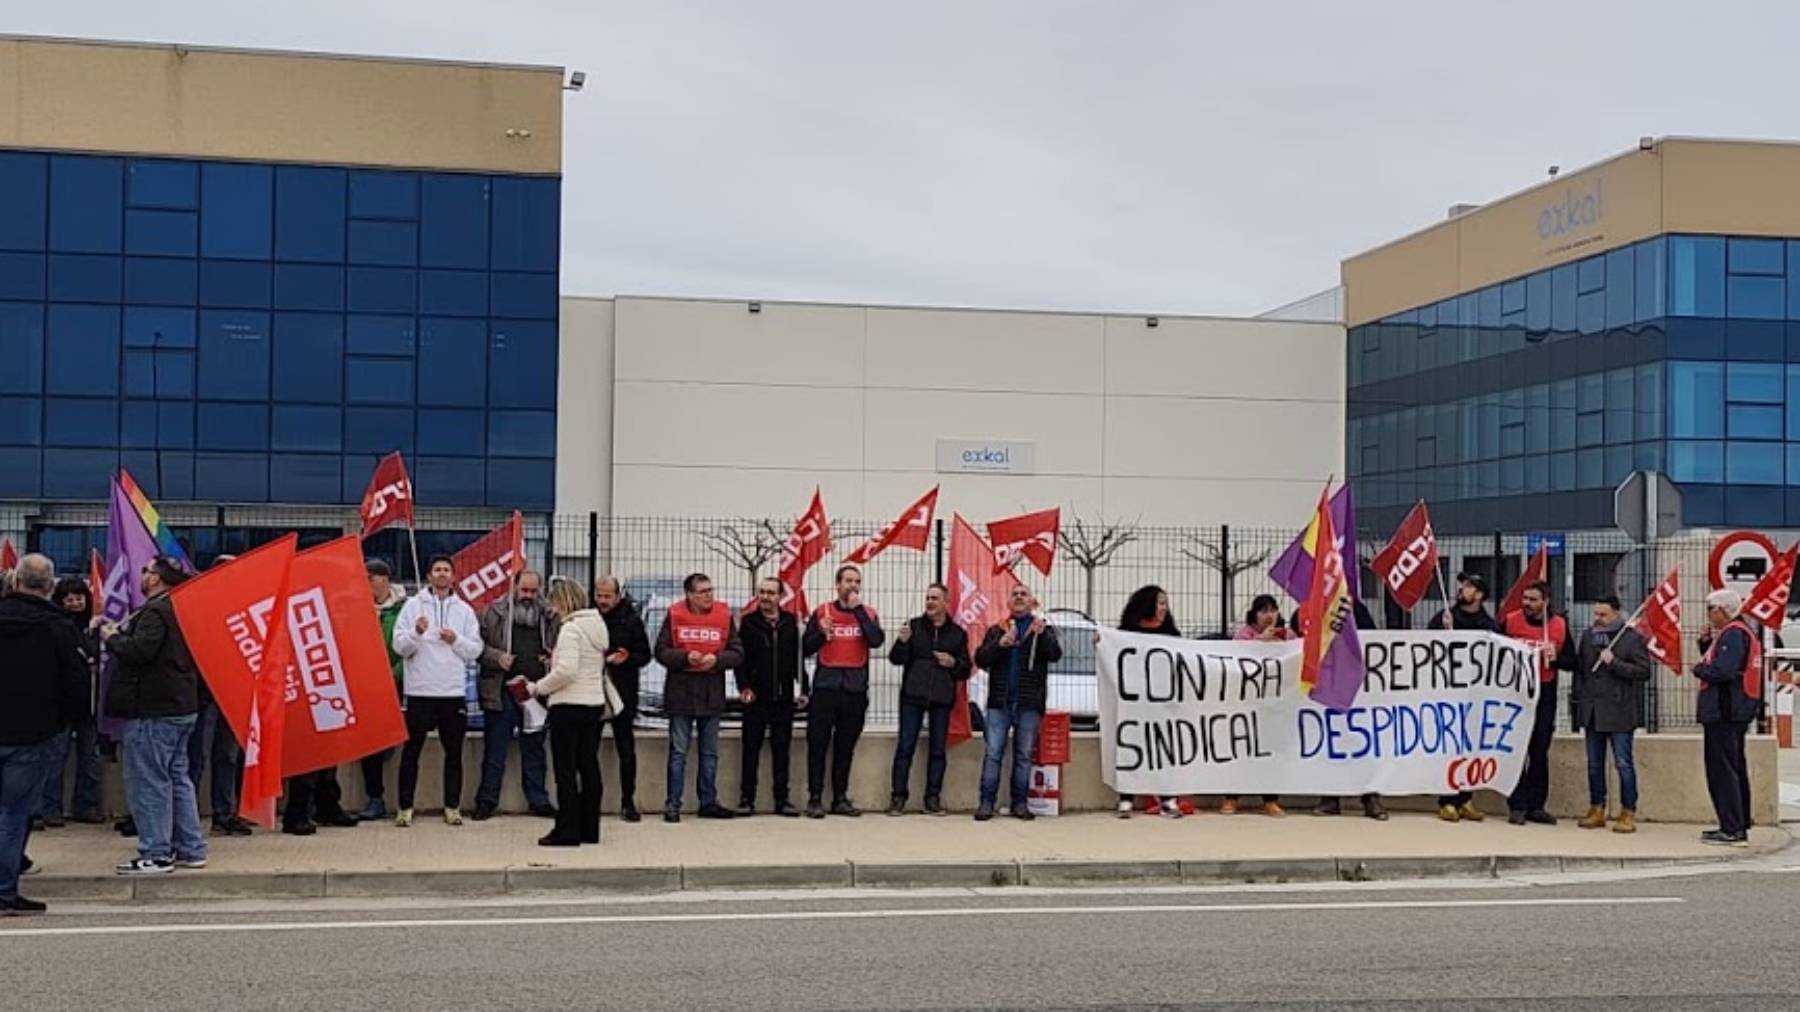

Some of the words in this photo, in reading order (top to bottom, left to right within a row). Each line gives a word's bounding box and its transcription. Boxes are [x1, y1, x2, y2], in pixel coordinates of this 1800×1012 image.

[1537, 177, 1603, 240] exkal
[961, 446, 1010, 464] exkal
[292, 598, 336, 687] CCOO
[679, 628, 720, 641] CCOO
[1117, 647, 1282, 703] CONTRA
[1363, 640, 1535, 699] REPRESION
[1115, 710, 1272, 771] SINDICAL
